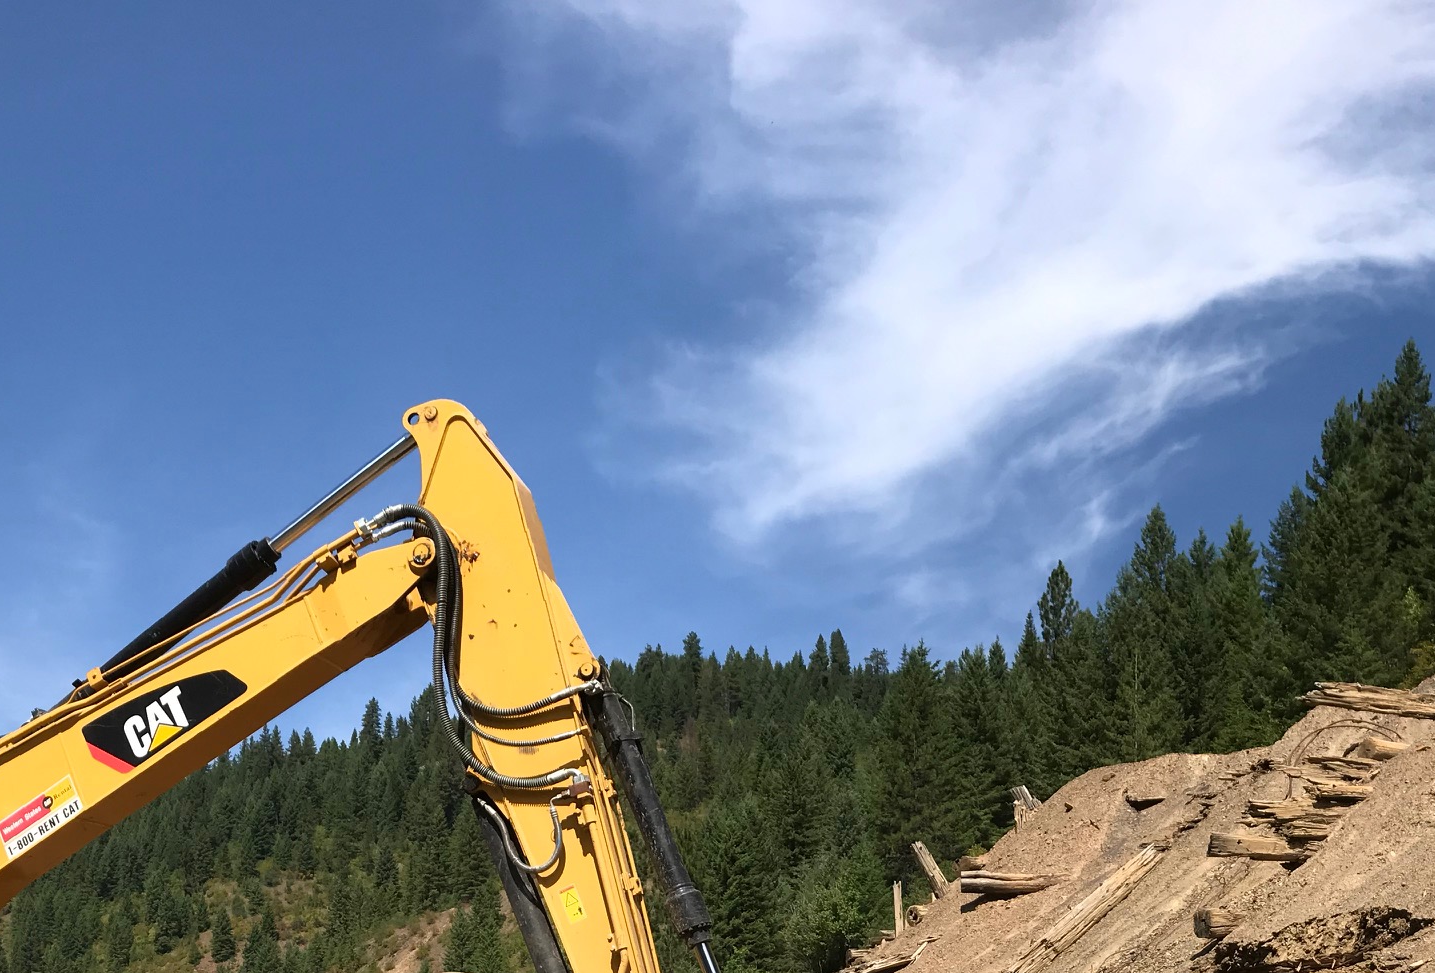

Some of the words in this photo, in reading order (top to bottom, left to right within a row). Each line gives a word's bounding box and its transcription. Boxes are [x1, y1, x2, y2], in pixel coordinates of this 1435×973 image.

[124, 685, 189, 758] CAT
[2, 818, 24, 836] Western
[24, 805, 42, 821] States
[53, 784, 72, 800] Rental
[7, 812, 61, 856] 1-800-RENT
[62, 799, 80, 819] CAT
